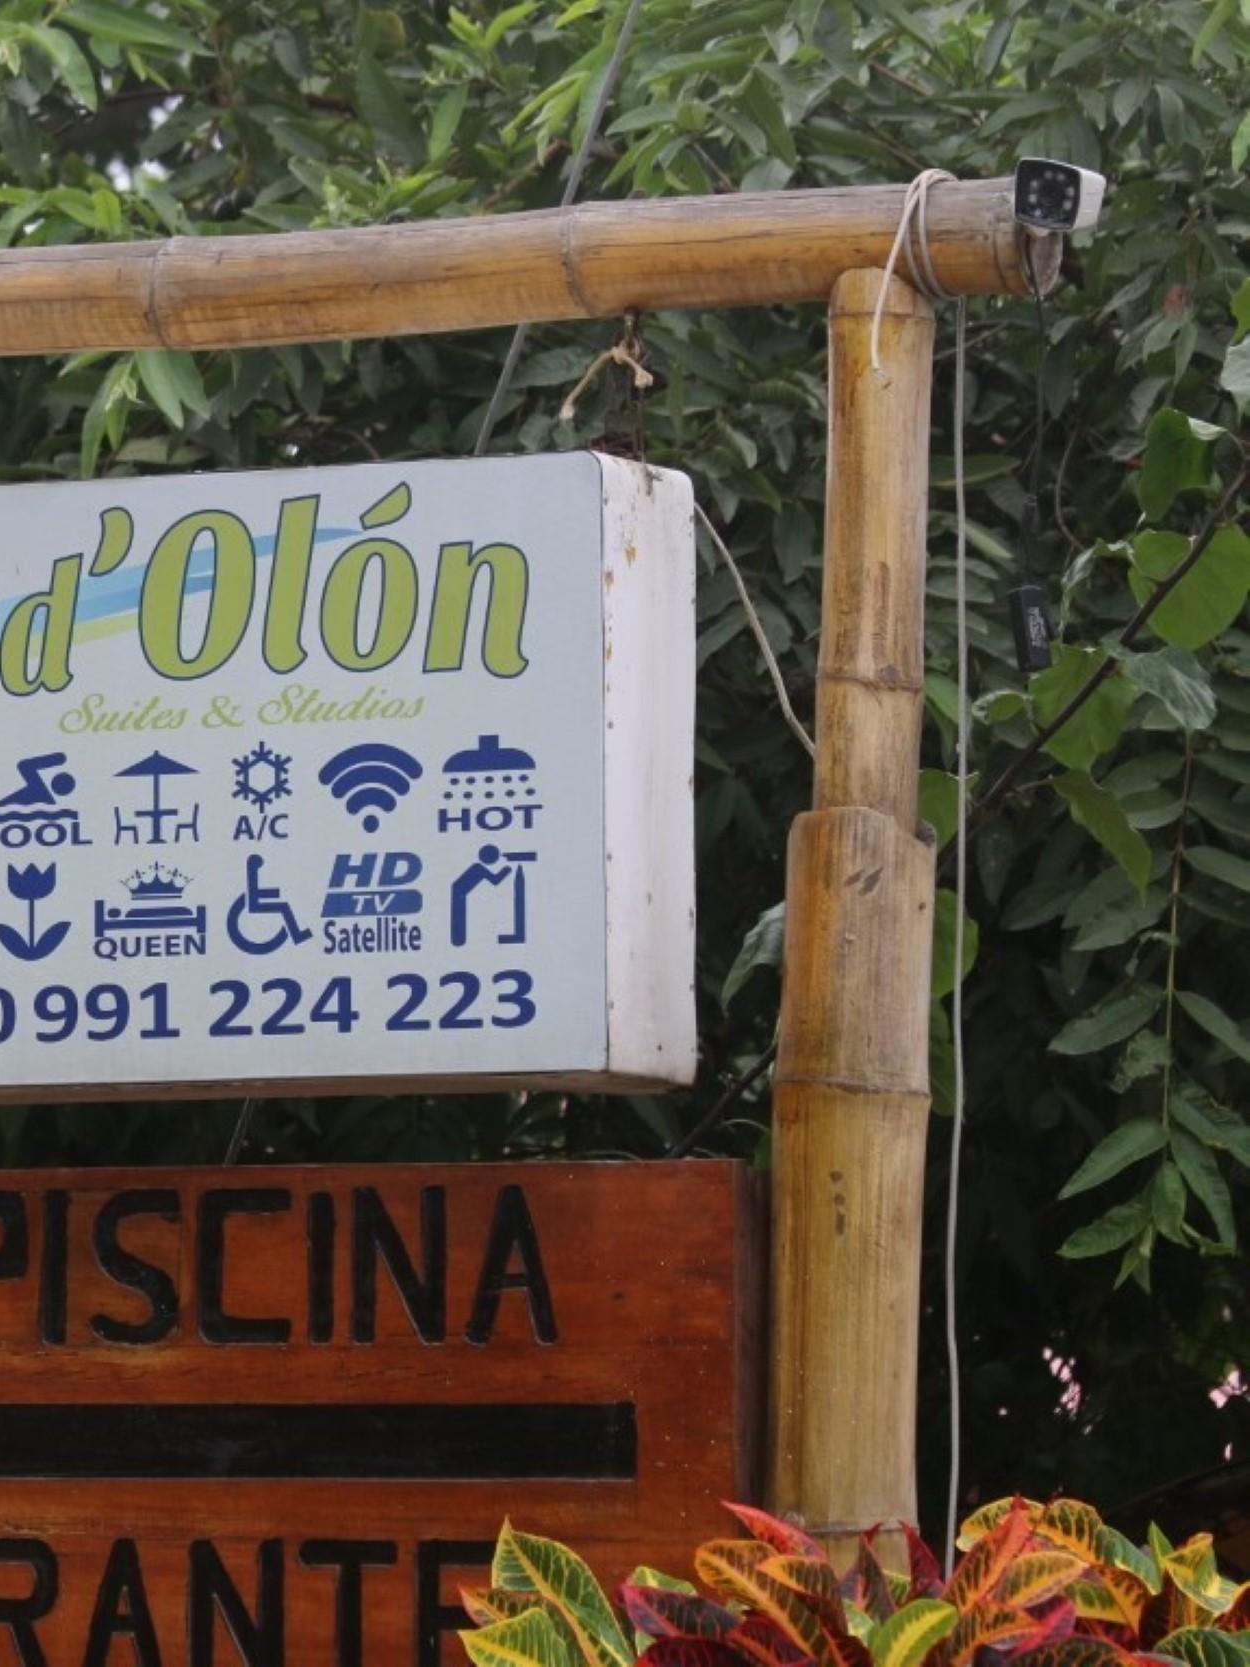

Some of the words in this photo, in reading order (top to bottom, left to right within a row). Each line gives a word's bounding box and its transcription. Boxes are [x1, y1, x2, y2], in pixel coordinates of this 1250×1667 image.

[58, 693, 187, 735] Suites
[199, 694, 245, 729] &
[257, 683, 426, 725] Studios
[232, 812, 290, 842] A/C
[437, 803, 544, 834] HOT
[328, 850, 424, 889] HD
[352, 894, 391, 912] TV
[93, 933, 207, 962] QUEEN
[323, 917, 423, 955] Satellite
[207, 975, 360, 1038] 224
[384, 968, 538, 1032] 223
